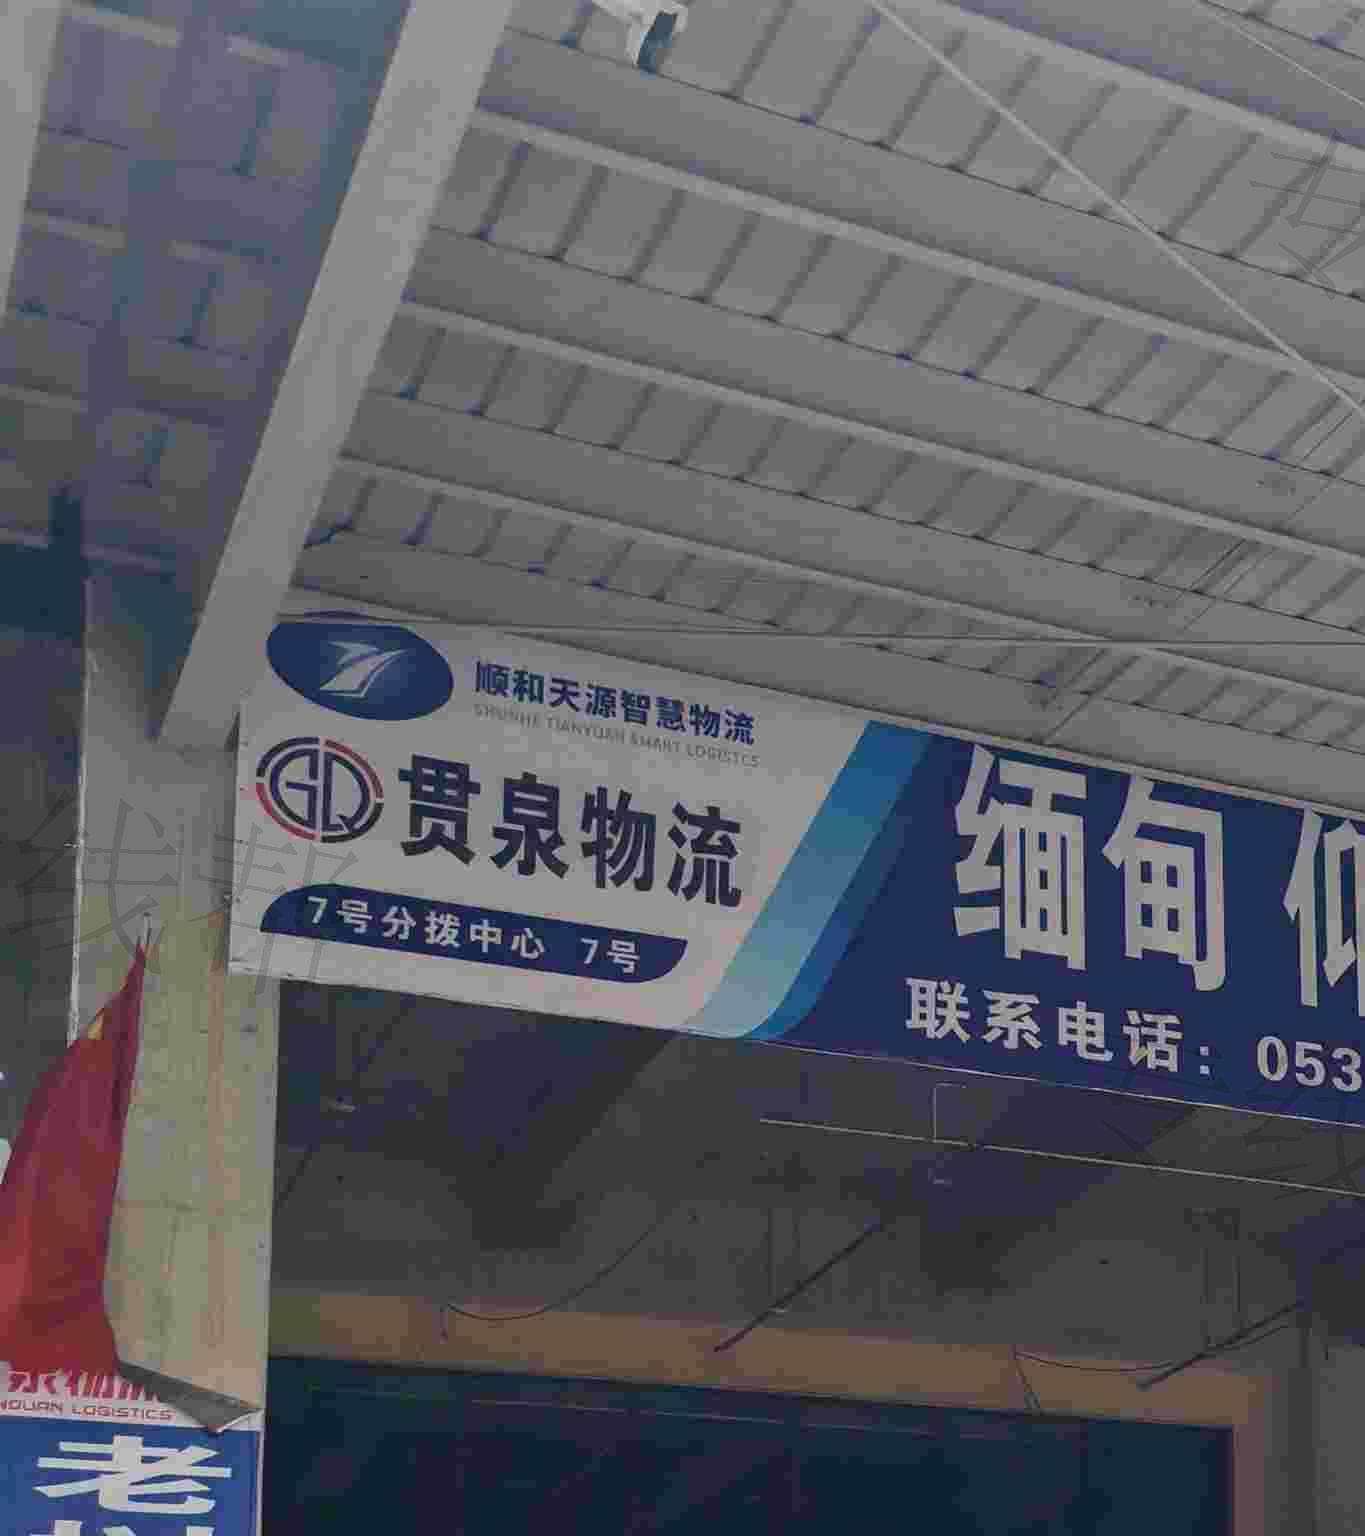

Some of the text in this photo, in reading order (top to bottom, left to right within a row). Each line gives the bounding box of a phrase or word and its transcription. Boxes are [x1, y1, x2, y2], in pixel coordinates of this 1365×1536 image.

[474, 659, 757, 746] 顺和天源智慧物流
[398, 753, 743, 908] 贯泉物流
[953, 743, 1227, 993] 缅甸
[306, 895, 641, 975] 7号分拨中心 7号
